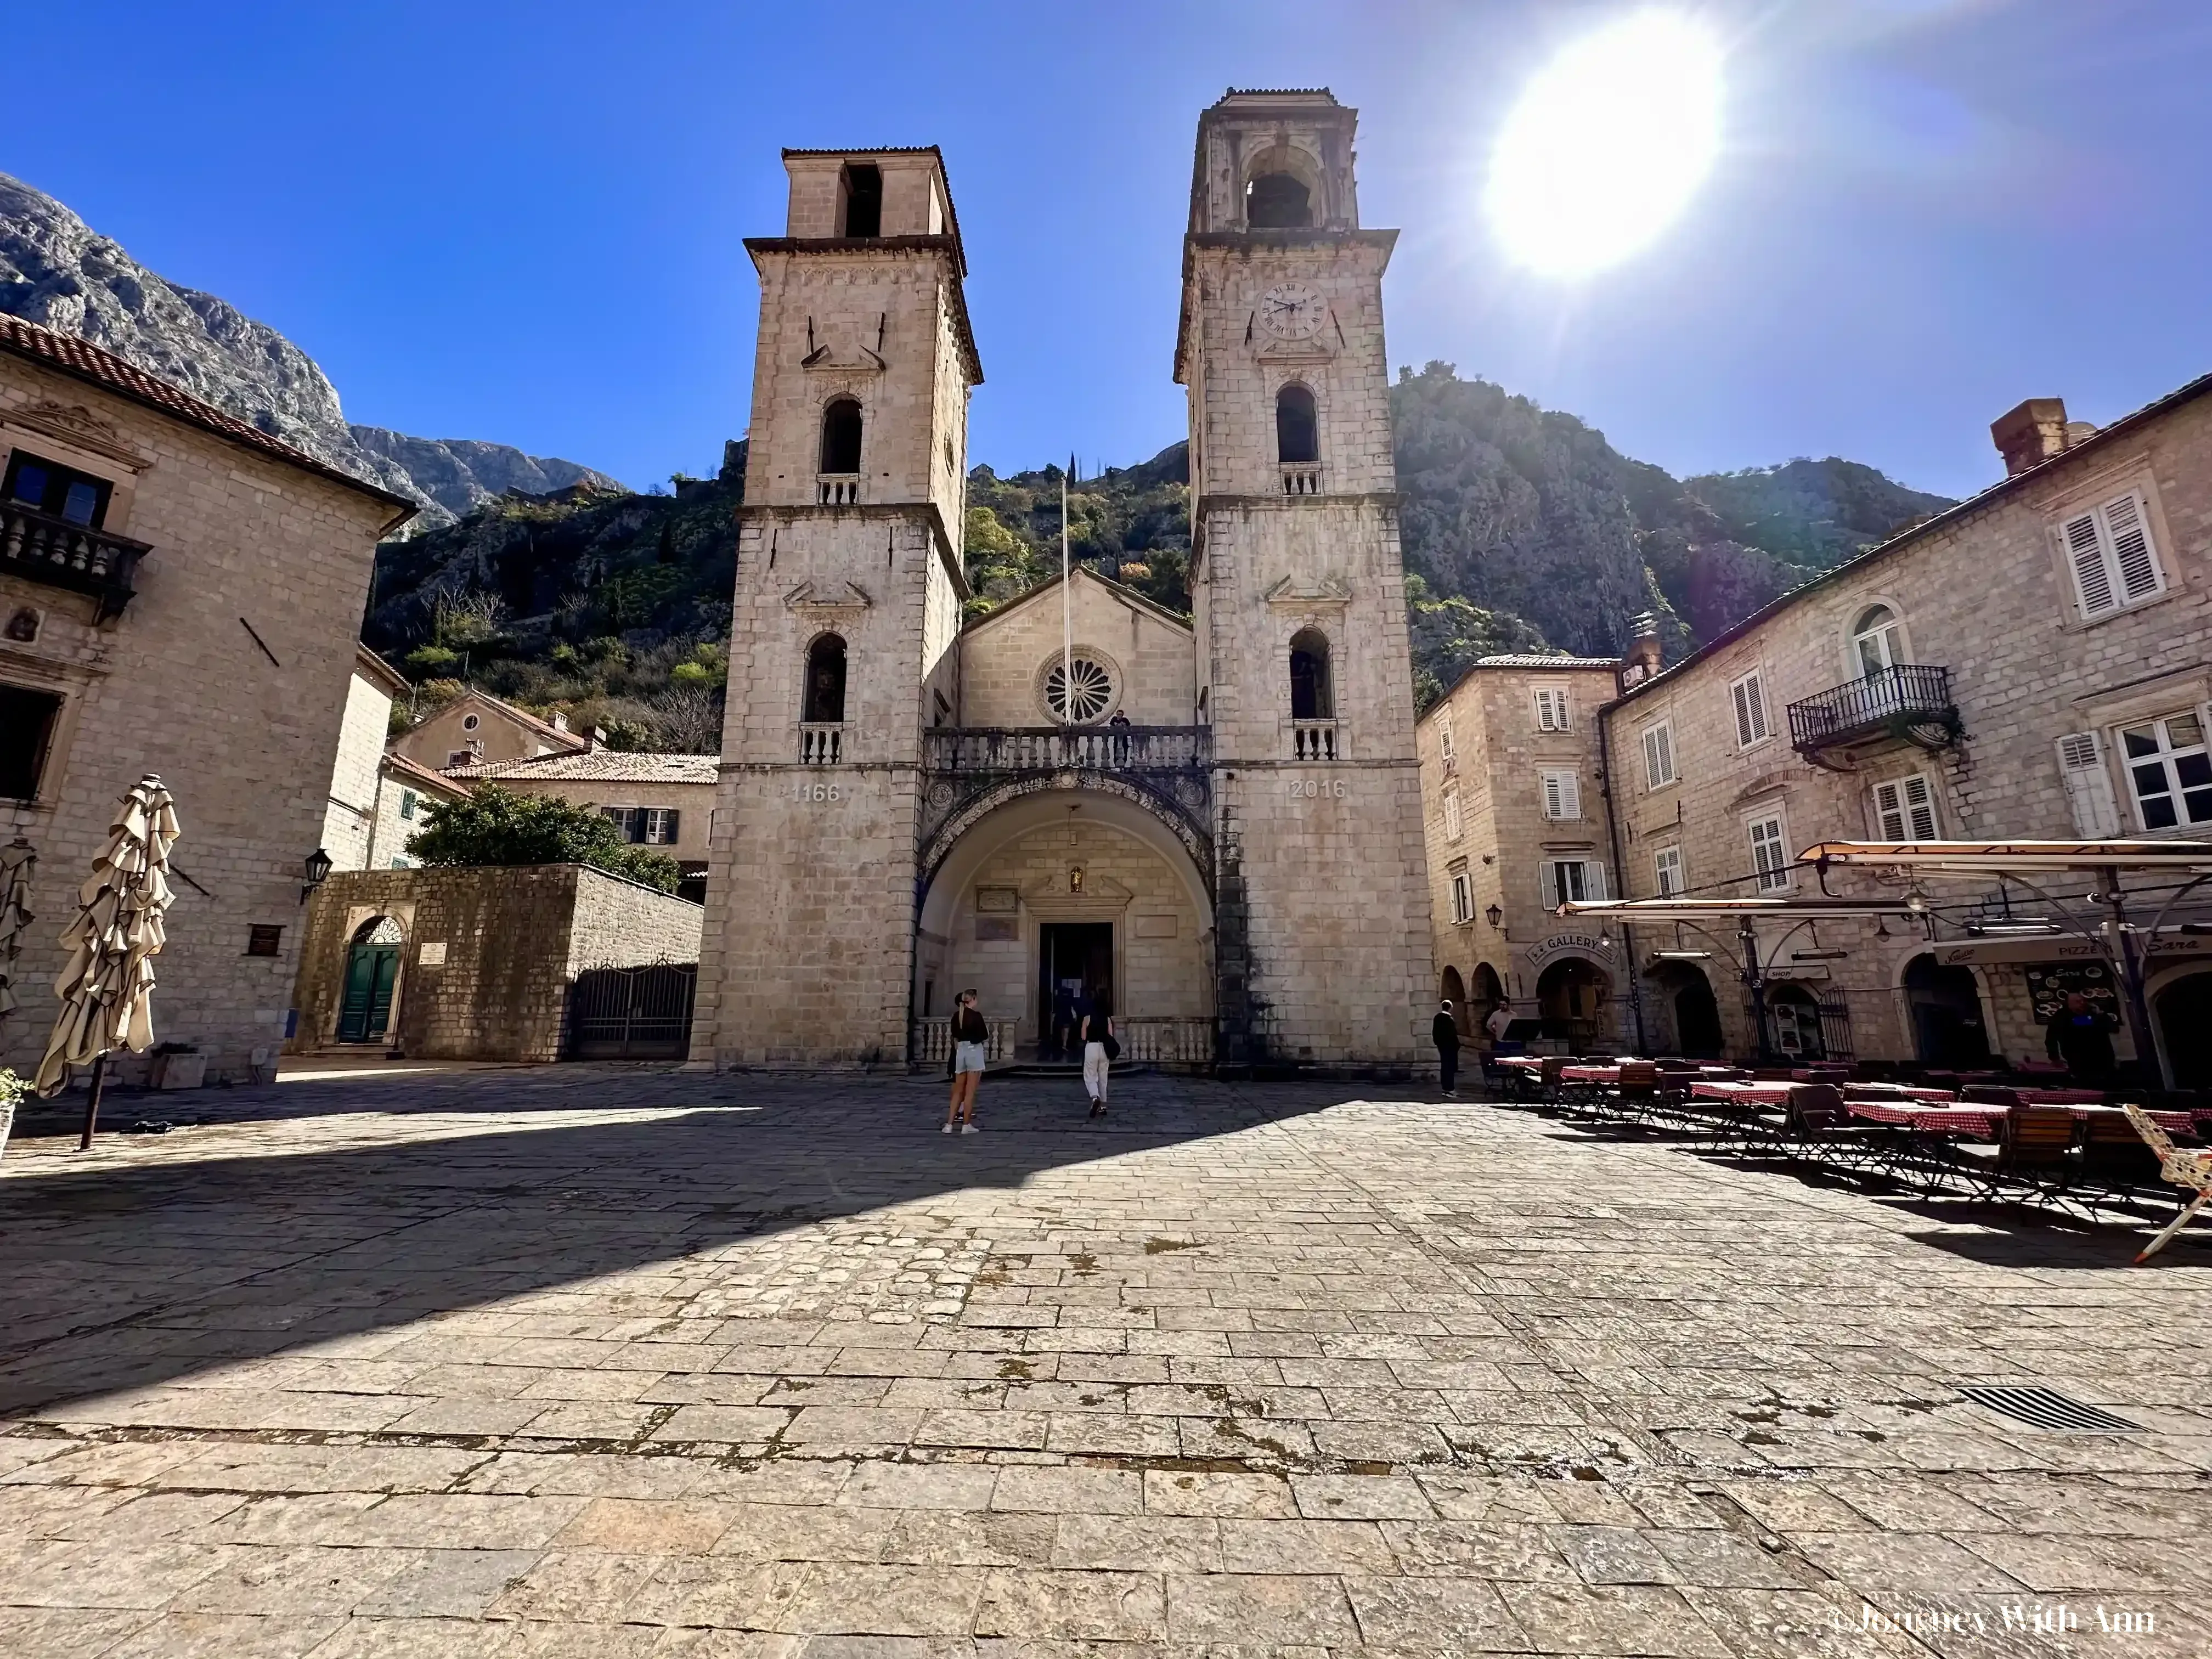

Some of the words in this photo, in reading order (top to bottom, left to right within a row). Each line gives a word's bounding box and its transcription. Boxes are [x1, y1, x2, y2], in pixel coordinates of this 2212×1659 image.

[792, 783, 839, 802] 1166
[1291, 779, 1346, 798] 2016
[1548, 935, 1599, 949] GALLERY
[2147, 938, 2200, 952] Sara
